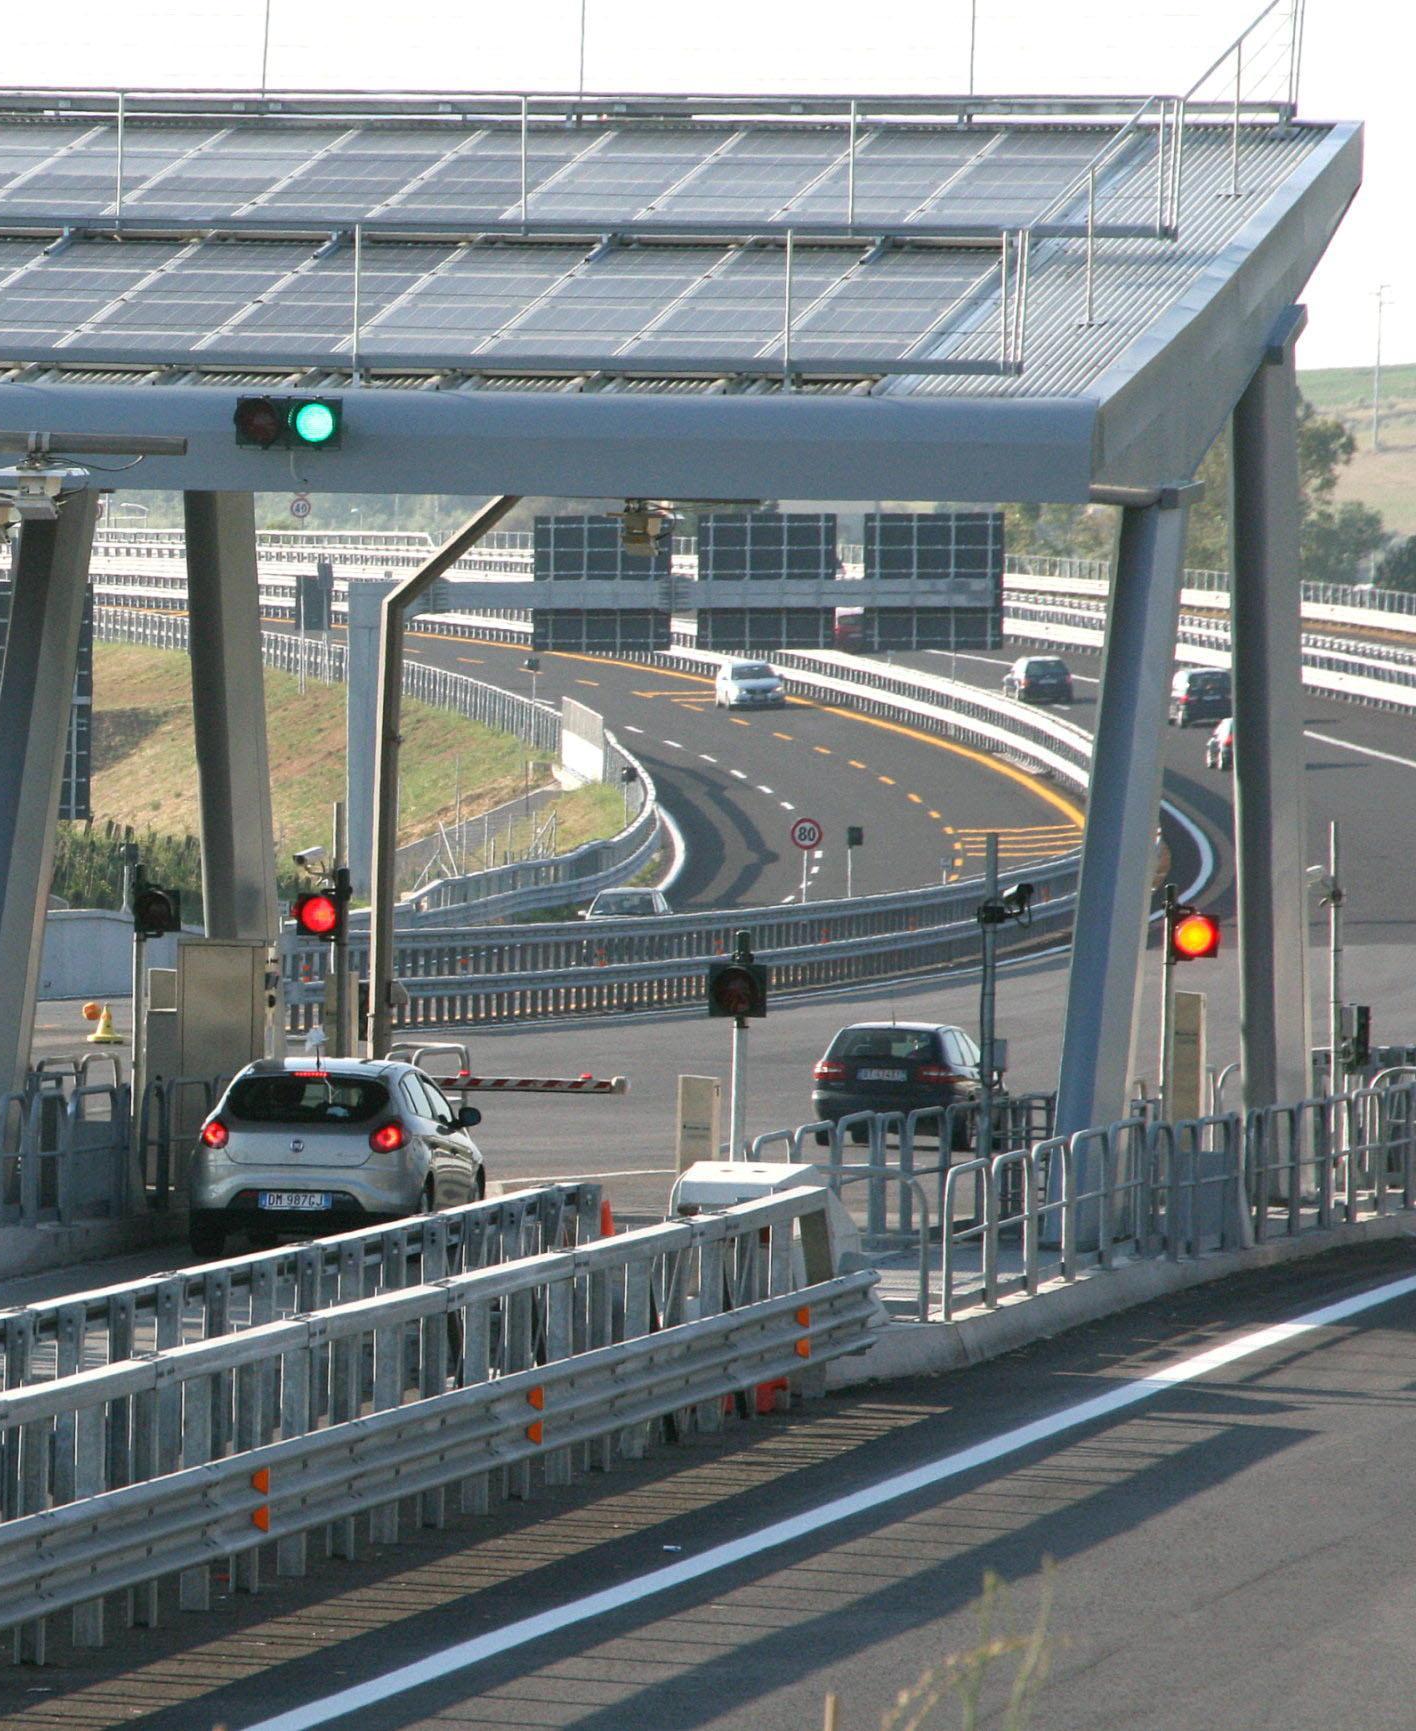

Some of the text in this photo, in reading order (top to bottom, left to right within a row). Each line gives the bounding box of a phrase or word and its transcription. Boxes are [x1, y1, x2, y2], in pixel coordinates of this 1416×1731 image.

[295, 503, 307, 513] 40
[798, 827, 816, 842] 80
[268, 1193, 283, 1206] DM
